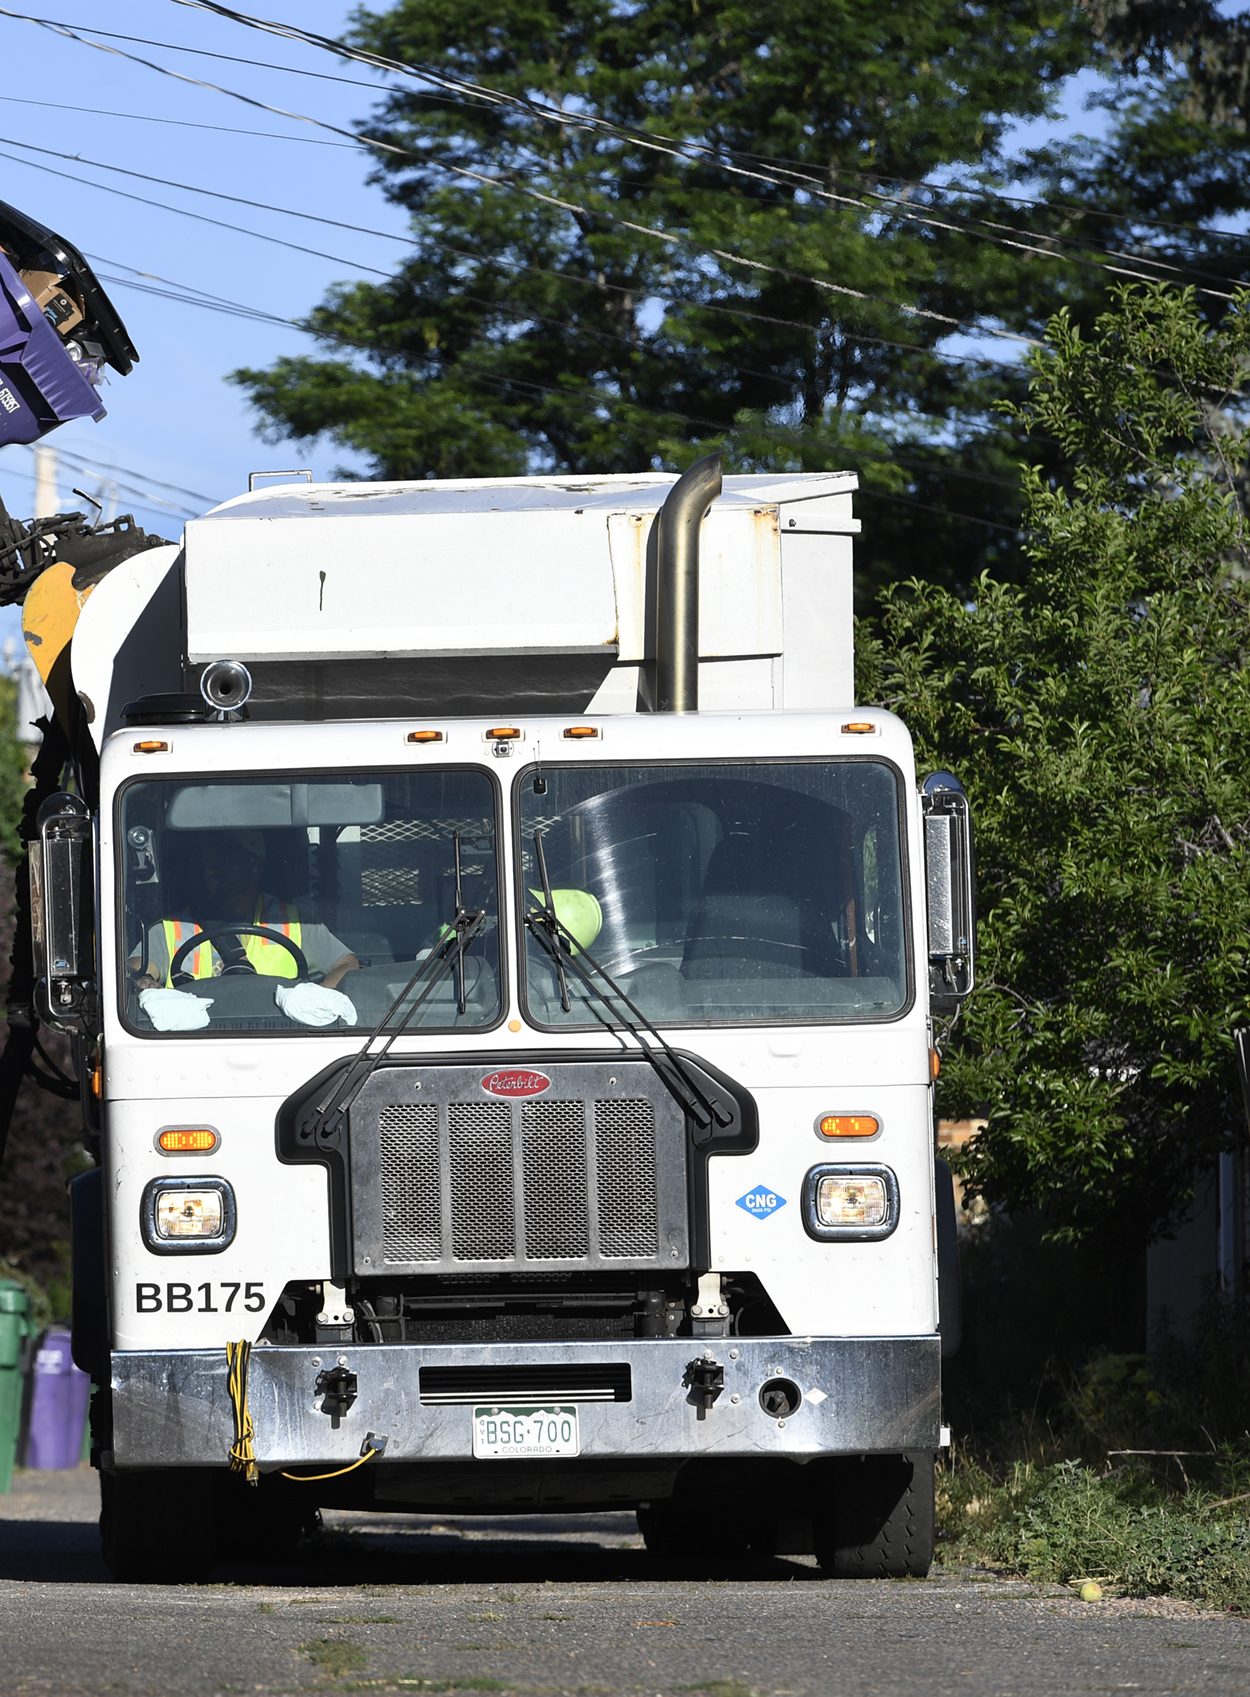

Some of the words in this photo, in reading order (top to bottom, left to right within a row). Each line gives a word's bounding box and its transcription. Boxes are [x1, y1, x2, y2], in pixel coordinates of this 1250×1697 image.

[490, 1075, 544, 1091] Peterbilt
[745, 1194, 777, 1208] CNG
[136, 1282, 266, 1313] BB175
[502, 1445, 553, 1454] COLORADO
